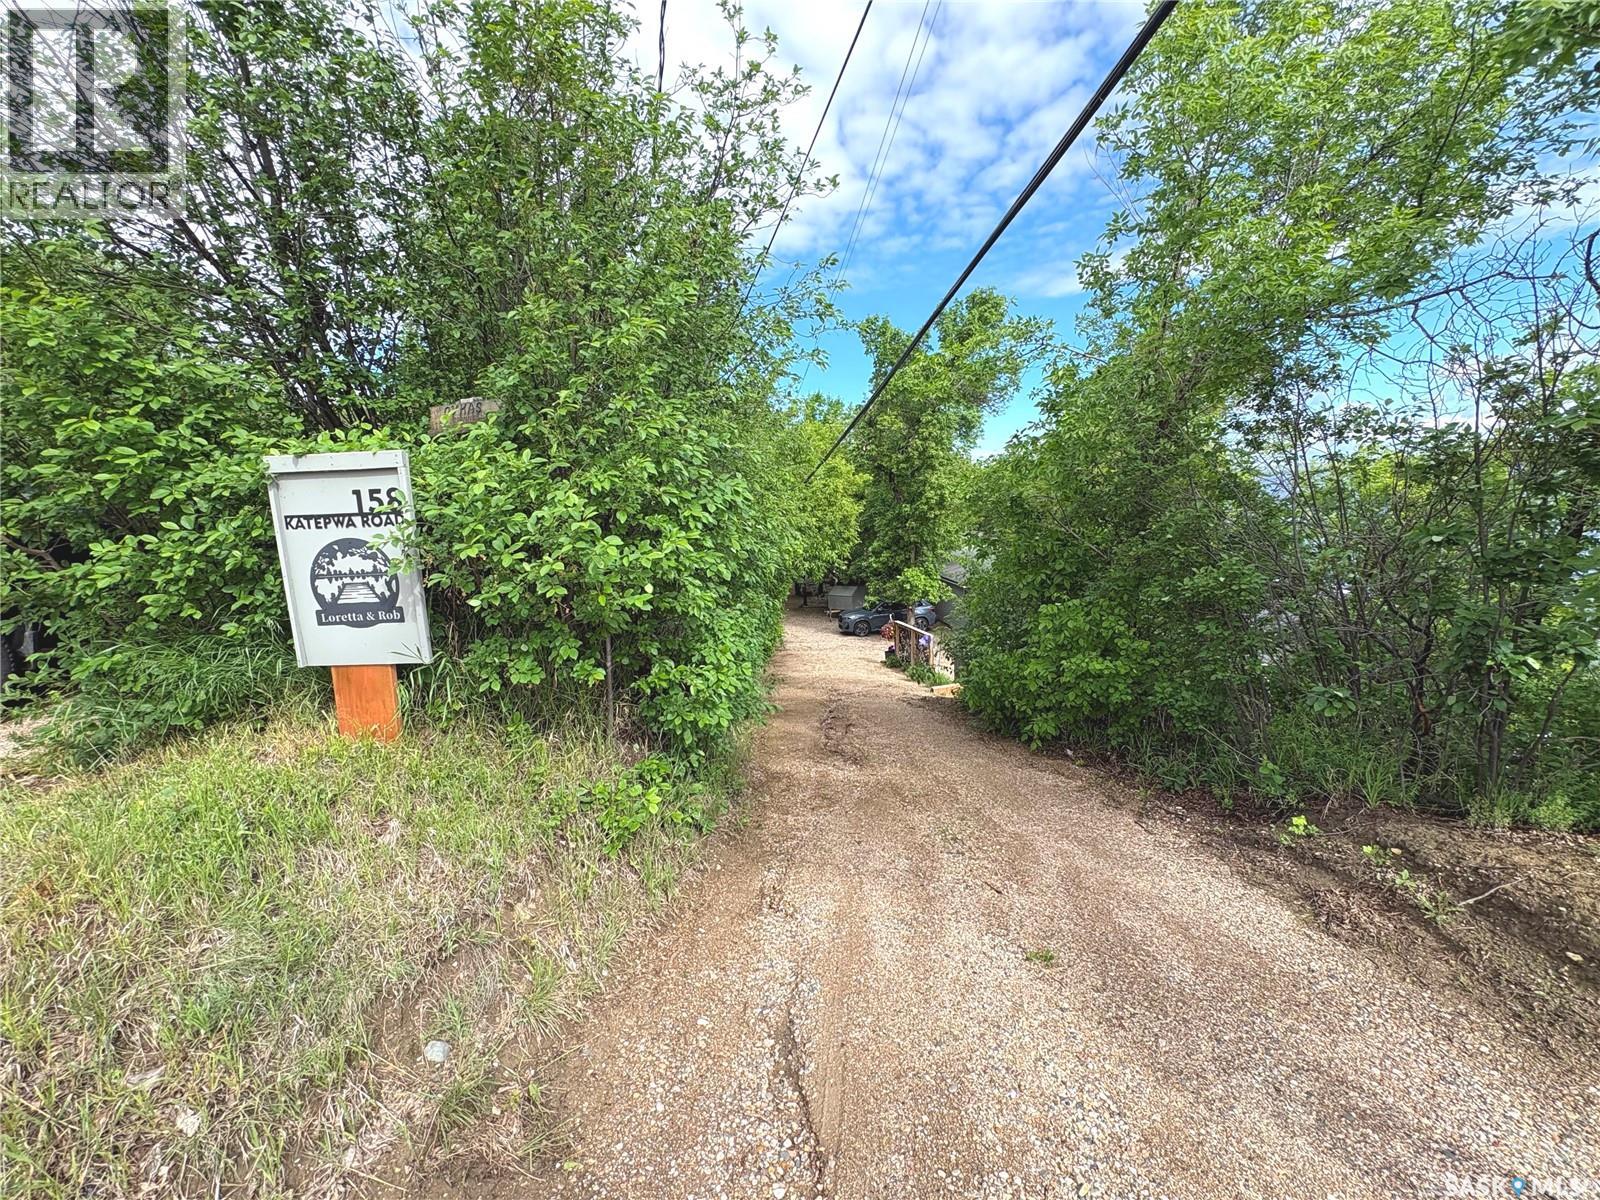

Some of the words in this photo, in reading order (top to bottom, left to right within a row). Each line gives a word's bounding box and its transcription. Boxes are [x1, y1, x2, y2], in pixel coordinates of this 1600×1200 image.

[352, 487, 403, 514] 158
[284, 513, 357, 530] KATEPWA
[361, 513, 404, 528] ROAD
[320, 612, 364, 623] Loretta
[366, 611, 376, 621] &
[378, 609, 401, 621] Rob
